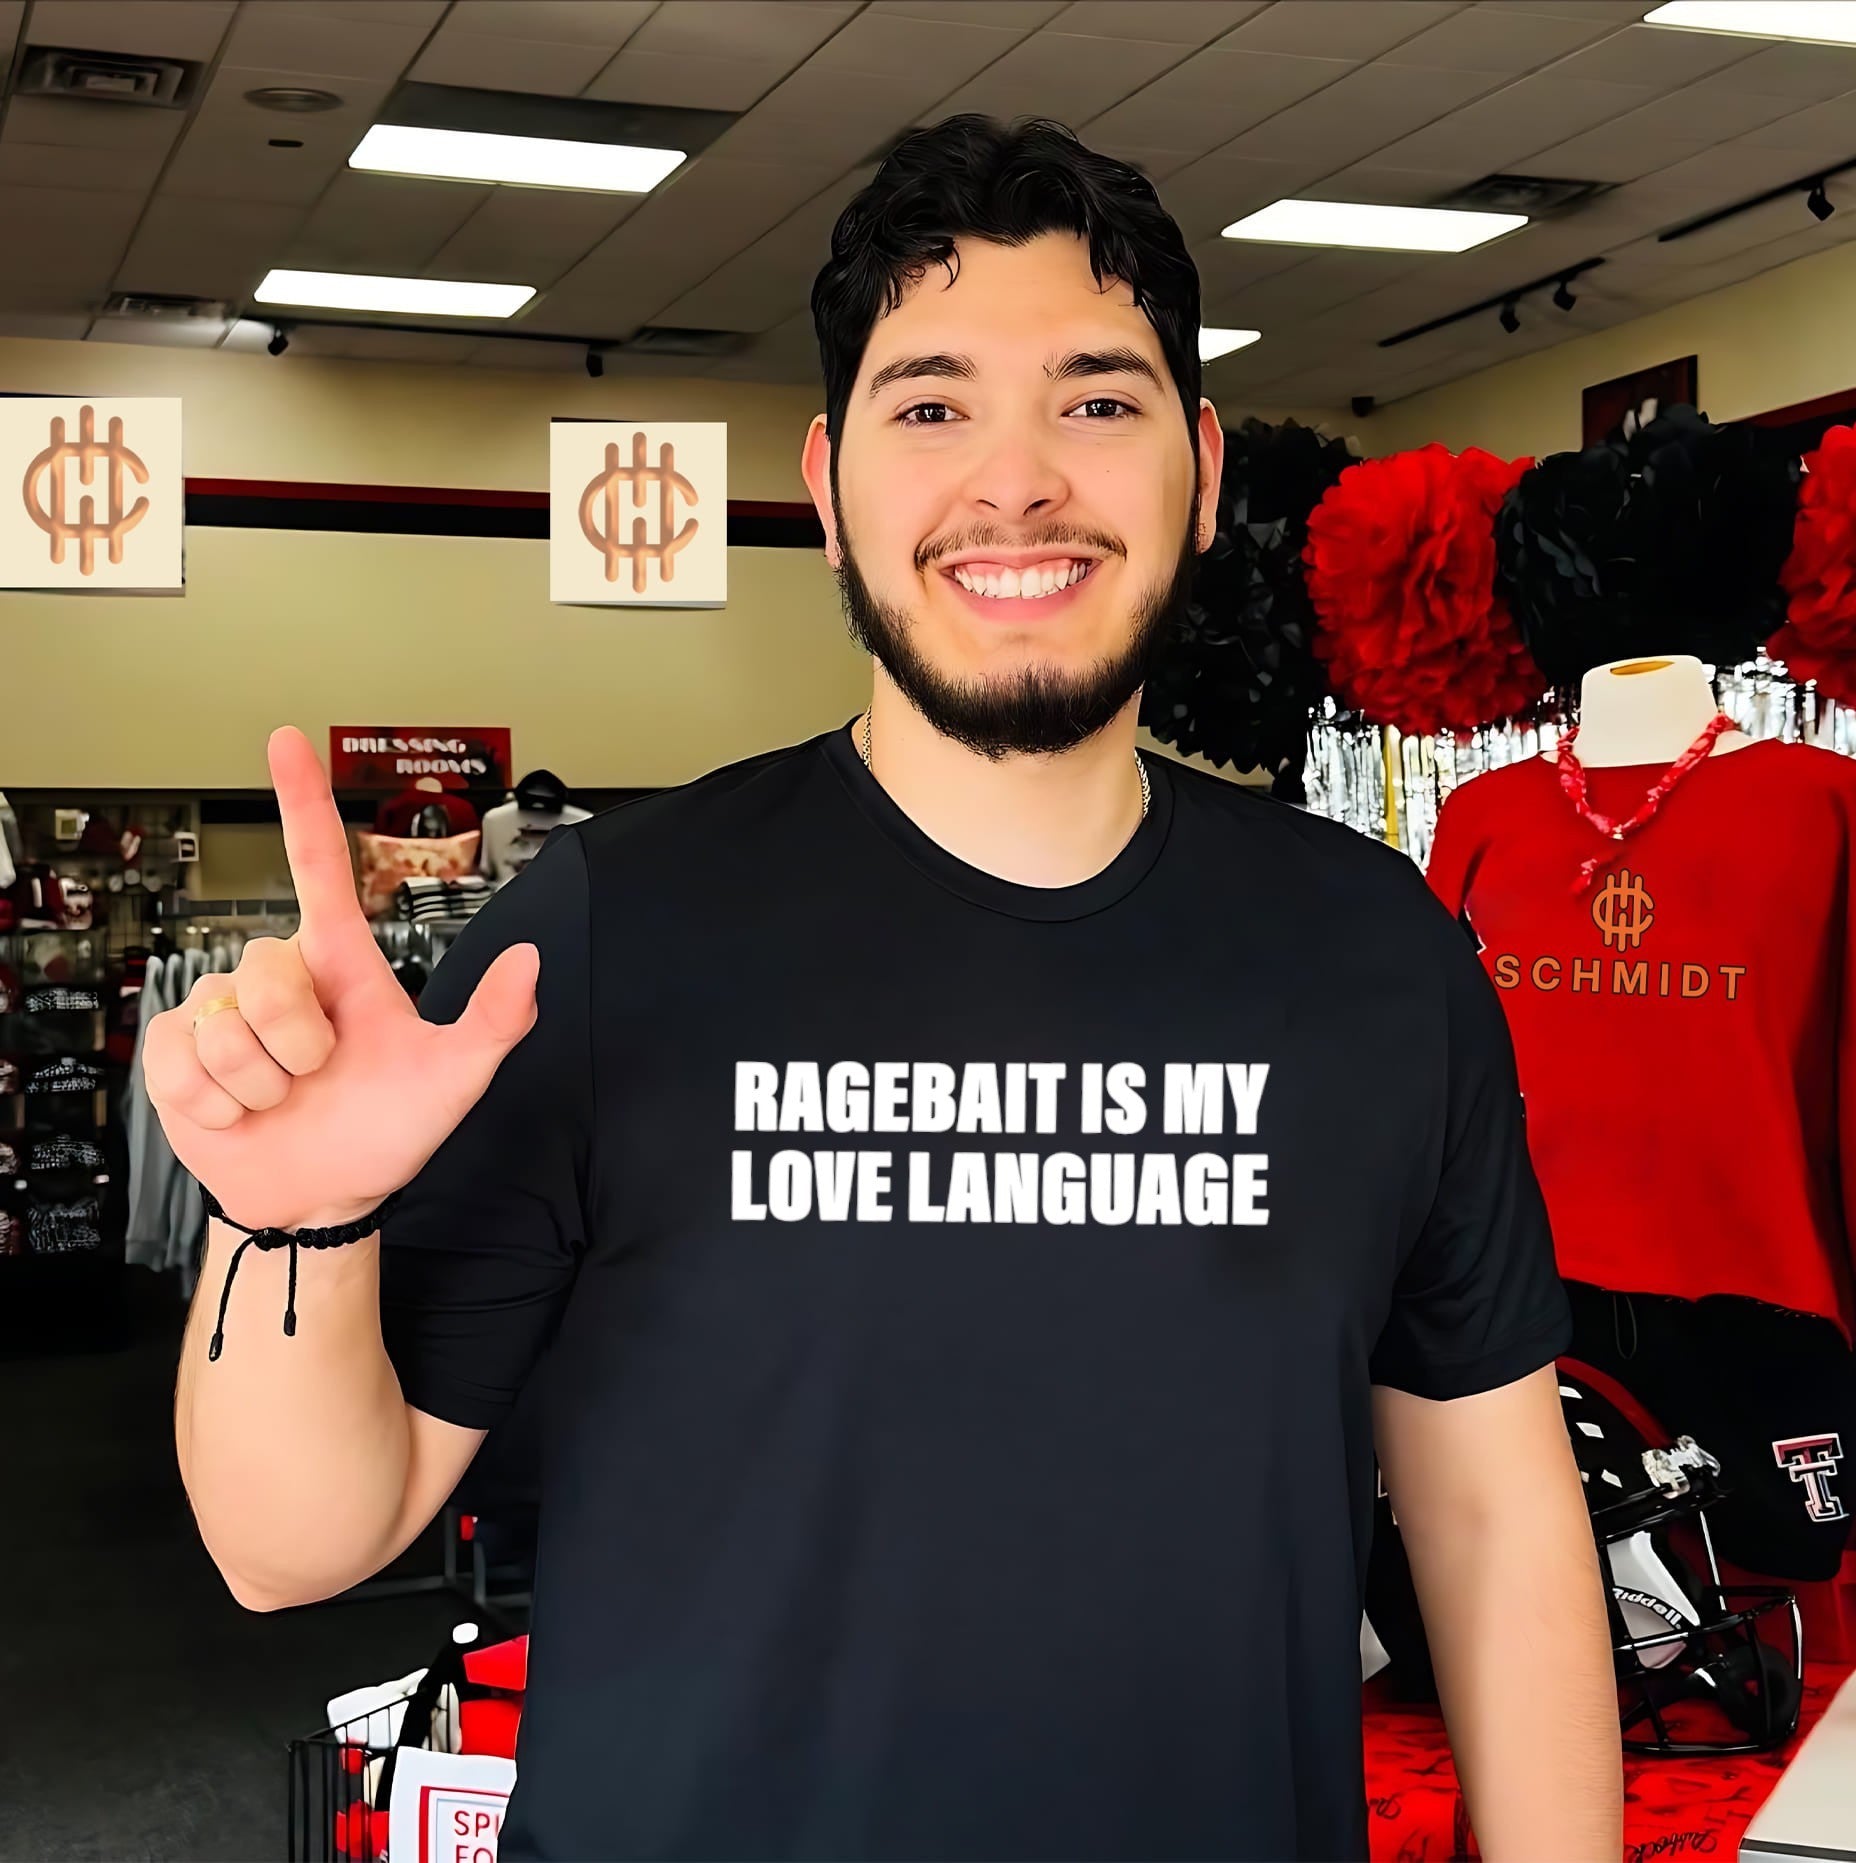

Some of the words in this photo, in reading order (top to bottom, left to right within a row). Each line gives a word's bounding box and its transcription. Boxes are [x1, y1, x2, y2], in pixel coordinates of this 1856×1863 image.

[342, 737, 466, 754] DRESSING
[396, 758, 487, 775] ROOMS
[1493, 953, 1747, 1000] SCHMIDT
[734, 1060, 1067, 1134] RAGEBAIT
[1080, 1061, 1148, 1136] IS
[1163, 1062, 1271, 1135] MY
[730, 1149, 894, 1222] LOVE
[907, 1151, 1271, 1226] LANGUAGE
